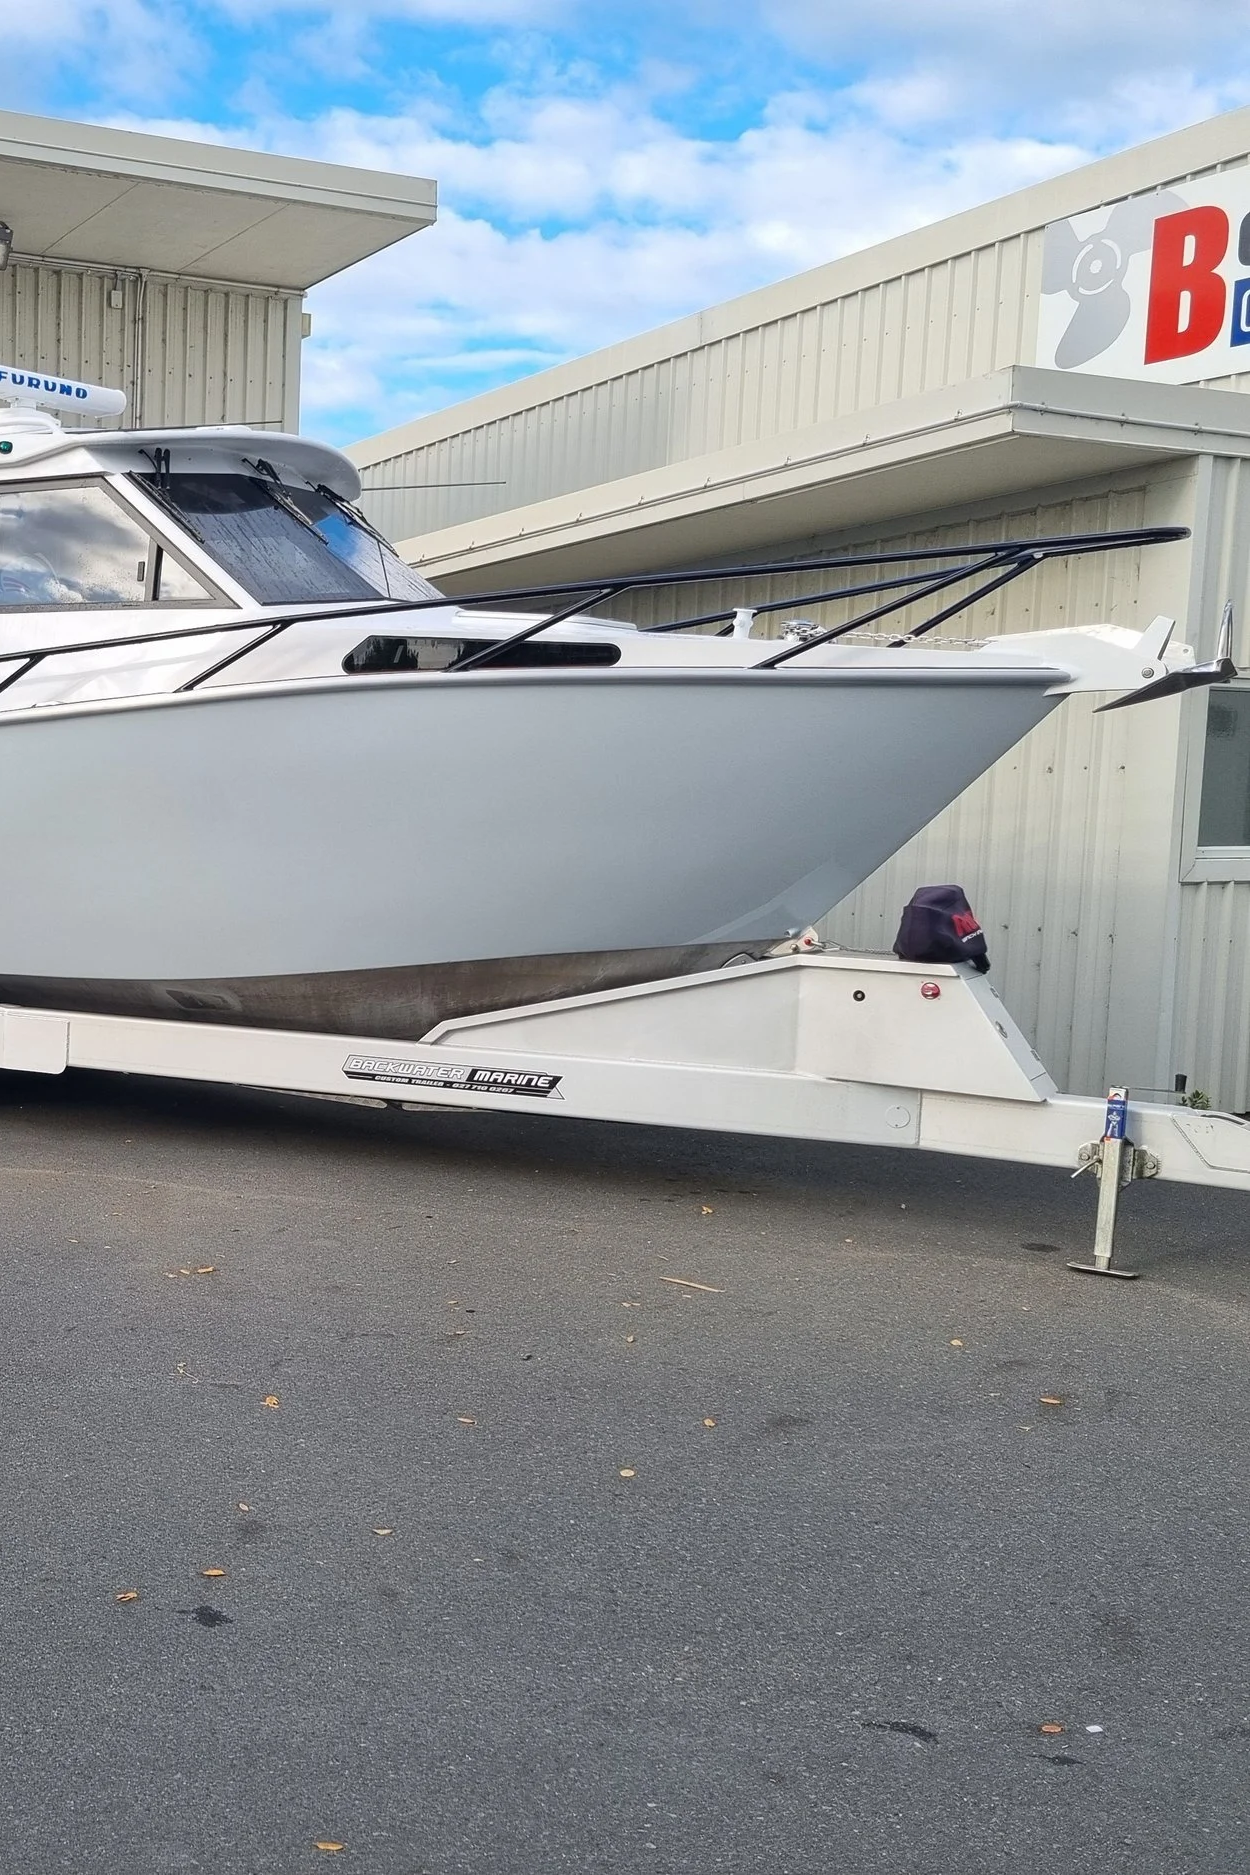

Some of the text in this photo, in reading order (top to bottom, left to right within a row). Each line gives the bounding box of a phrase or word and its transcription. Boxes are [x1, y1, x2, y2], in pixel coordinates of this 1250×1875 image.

[1144, 205, 1250, 366] B
[349, 1057, 554, 1088] BACKWATER MARINE
[374, 1075, 410, 1083] CUSTOM
